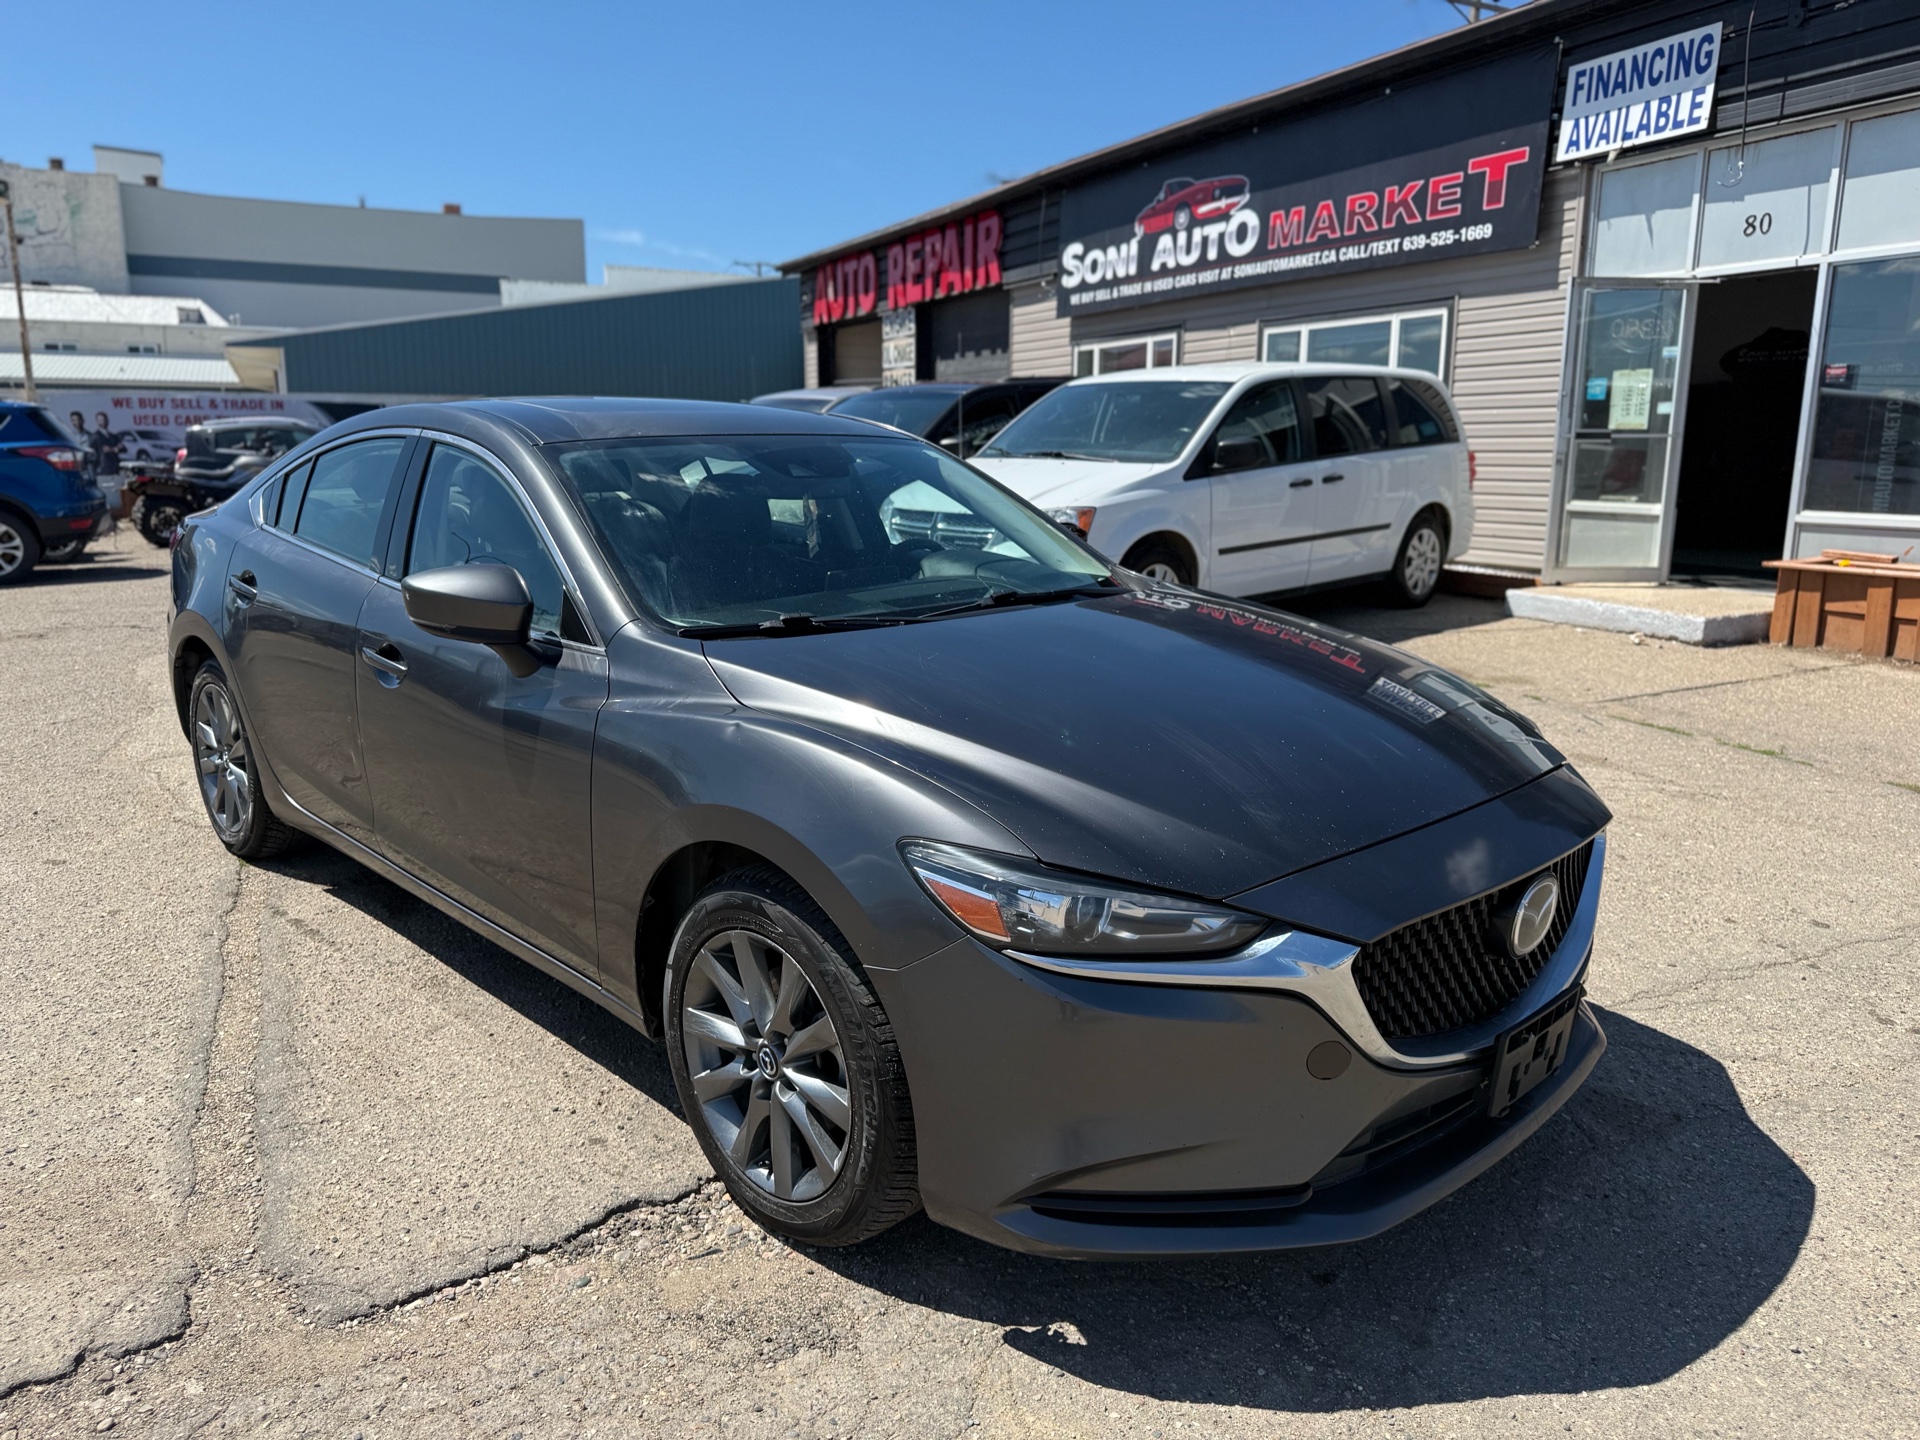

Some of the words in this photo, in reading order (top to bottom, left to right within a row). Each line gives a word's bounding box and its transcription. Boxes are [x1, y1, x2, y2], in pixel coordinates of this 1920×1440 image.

[1571, 33, 1715, 107] FINANCING
[1564, 87, 1707, 154] AVAILABLE
[1061, 239, 1139, 289] SONI
[1150, 208, 1260, 272] AUTO
[1267, 146, 1529, 250] MARKET
[1743, 212, 1772, 237] 80
[813, 252, 877, 325] AUTO
[887, 209, 1003, 310] REPAIR
[1095, 288, 1111, 302] SELL
[1119, 282, 1142, 298] TRADE
[1143, 280, 1153, 294] IN
[1153, 276, 1173, 292] USED
[1174, 271, 1197, 288] CARS
[1197, 267, 1220, 284] VISIT
[1220, 264, 1233, 281] AT
[1233, 248, 1337, 279] SONIAUTOMARKET.CA
[1338, 238, 1401, 263] CALL/TEXT
[1402, 223, 1493, 251] 639-525-1669
[112, 396, 134, 410] WE
[138, 397, 166, 410] BUY
[171, 397, 204, 410] SELL
[209, 397, 218, 410] &
[222, 398, 266, 411] TRADE
[270, 399, 284, 411] IN
[133, 414, 169, 426] USED
